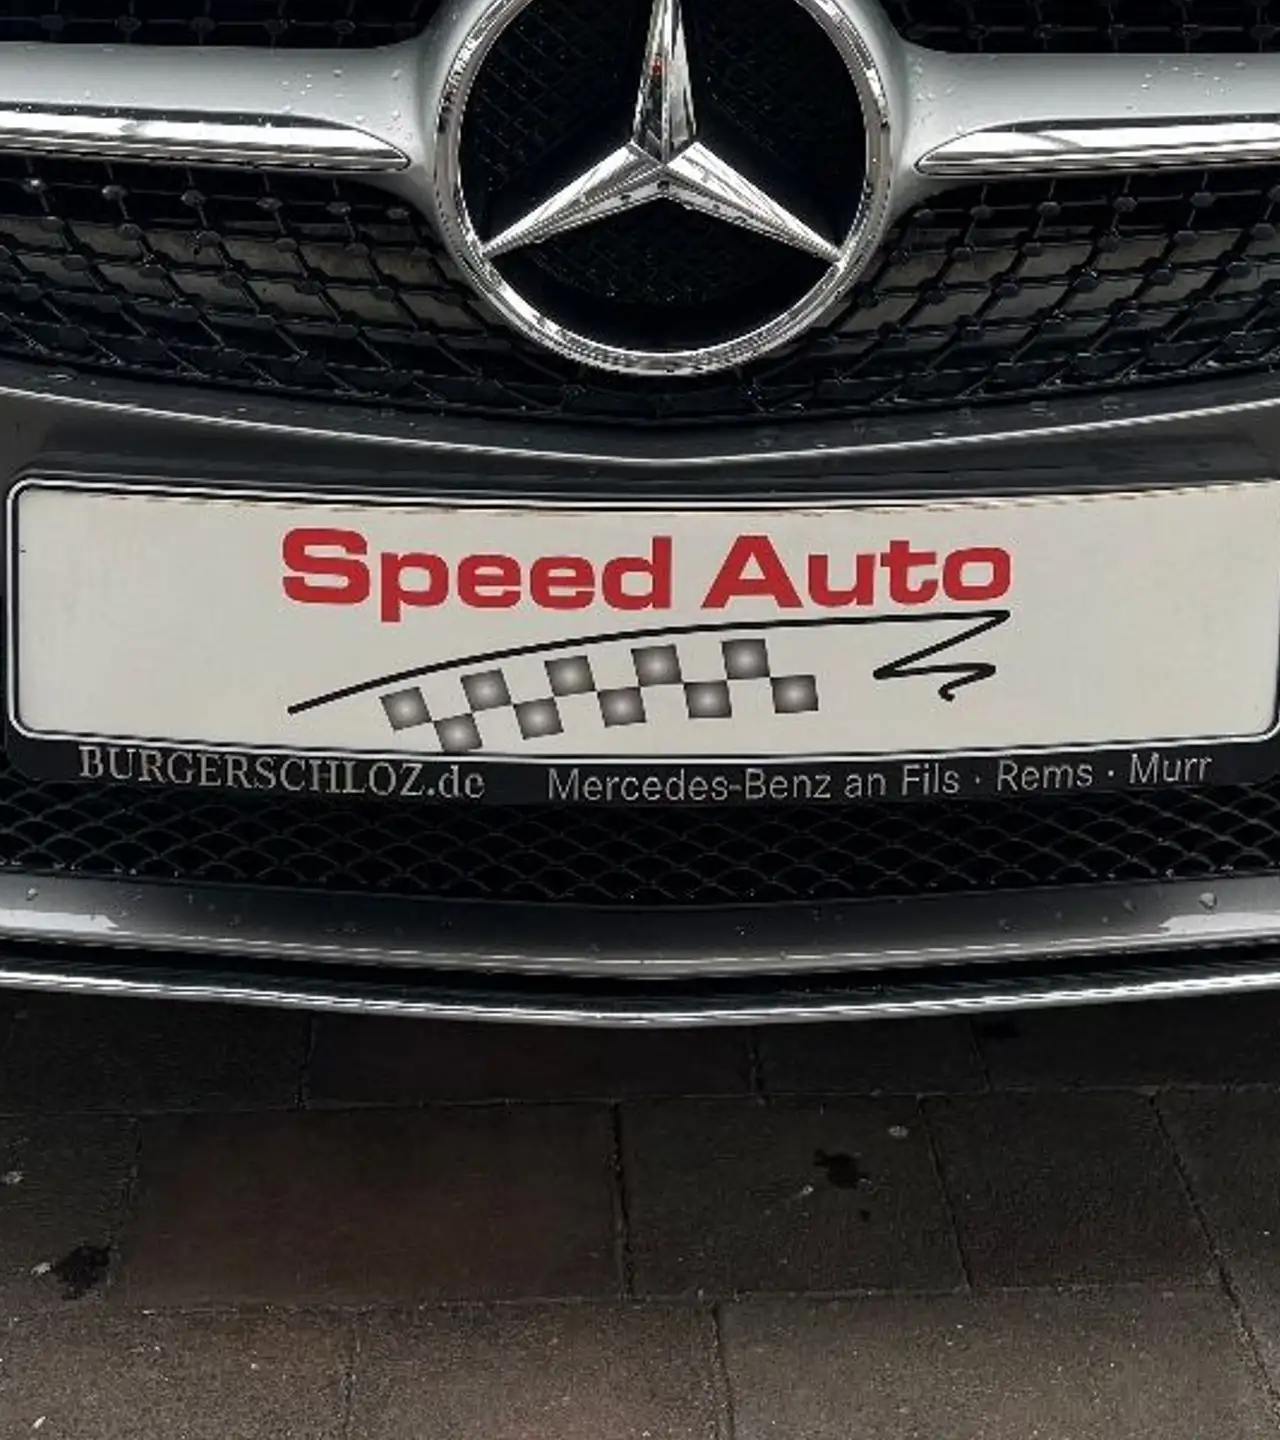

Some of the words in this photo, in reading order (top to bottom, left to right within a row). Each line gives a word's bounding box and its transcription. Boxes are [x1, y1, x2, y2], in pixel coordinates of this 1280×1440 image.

[282, 527, 673, 624] Speed
[701, 535, 1013, 610] Auto
[78, 745, 486, 799] BURGERSCHLOZ.de
[547, 767, 832, 802] Mercedes-Benz
[843, 772, 887, 798] an
[901, 763, 961, 797] Fils
[996, 760, 1094, 793] Rems
[1129, 752, 1213, 785] Murr
